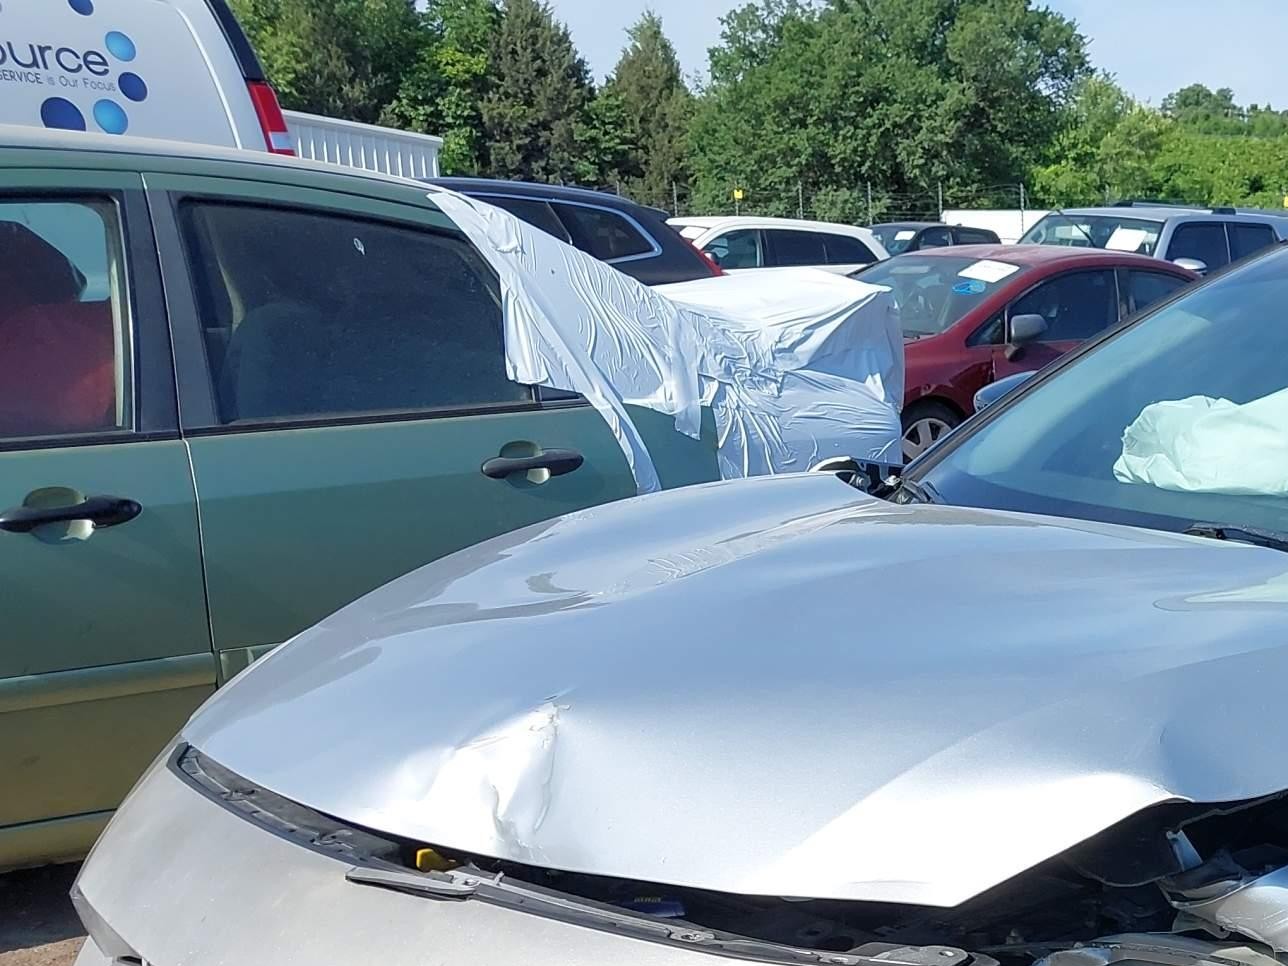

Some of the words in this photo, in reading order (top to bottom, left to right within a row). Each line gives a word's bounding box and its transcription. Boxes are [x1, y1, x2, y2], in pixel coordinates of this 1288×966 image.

[0, 41, 110, 76] urce
[59, 75, 79, 89] Our
[83, 78, 117, 92] Focus
